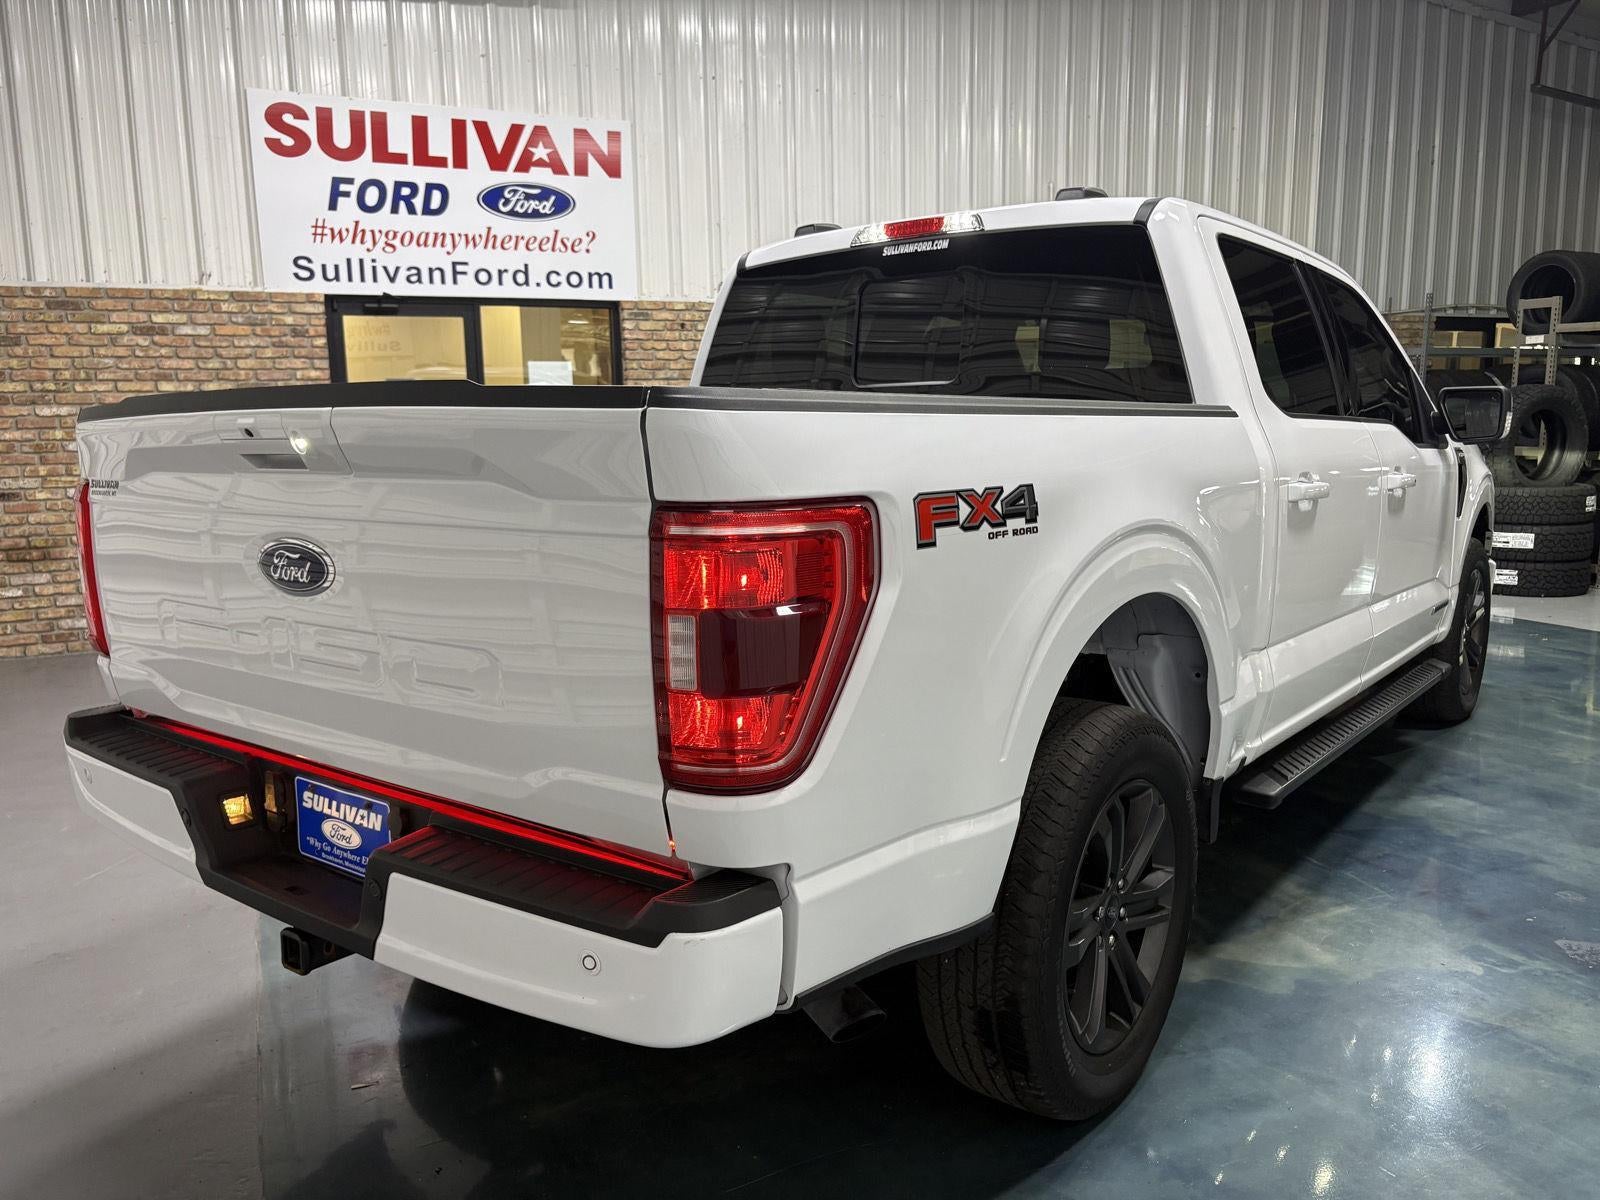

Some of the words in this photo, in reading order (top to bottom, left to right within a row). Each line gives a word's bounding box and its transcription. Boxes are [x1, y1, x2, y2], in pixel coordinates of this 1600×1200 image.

[264, 101, 622, 179] SULLIVAN
[327, 176, 450, 216] FORD
[498, 186, 556, 215] Ford
[310, 218, 597, 255] #whygoanywhereelse?
[882, 239, 950, 257] SULLIVANFORD.COM
[292, 255, 614, 290] SullivanFord.com
[90, 479, 119, 489] SULLIVAN
[913, 483, 1039, 549] FX4
[988, 530, 1009, 540] OFF
[1012, 526, 1039, 537] ROAD
[270, 550, 311, 583] Ford
[302, 791, 383, 832] SULLIVAN
[329, 823, 353, 845] Ford
[322, 842, 331, 852] Go
[332, 847, 361, 863] Anywhere
